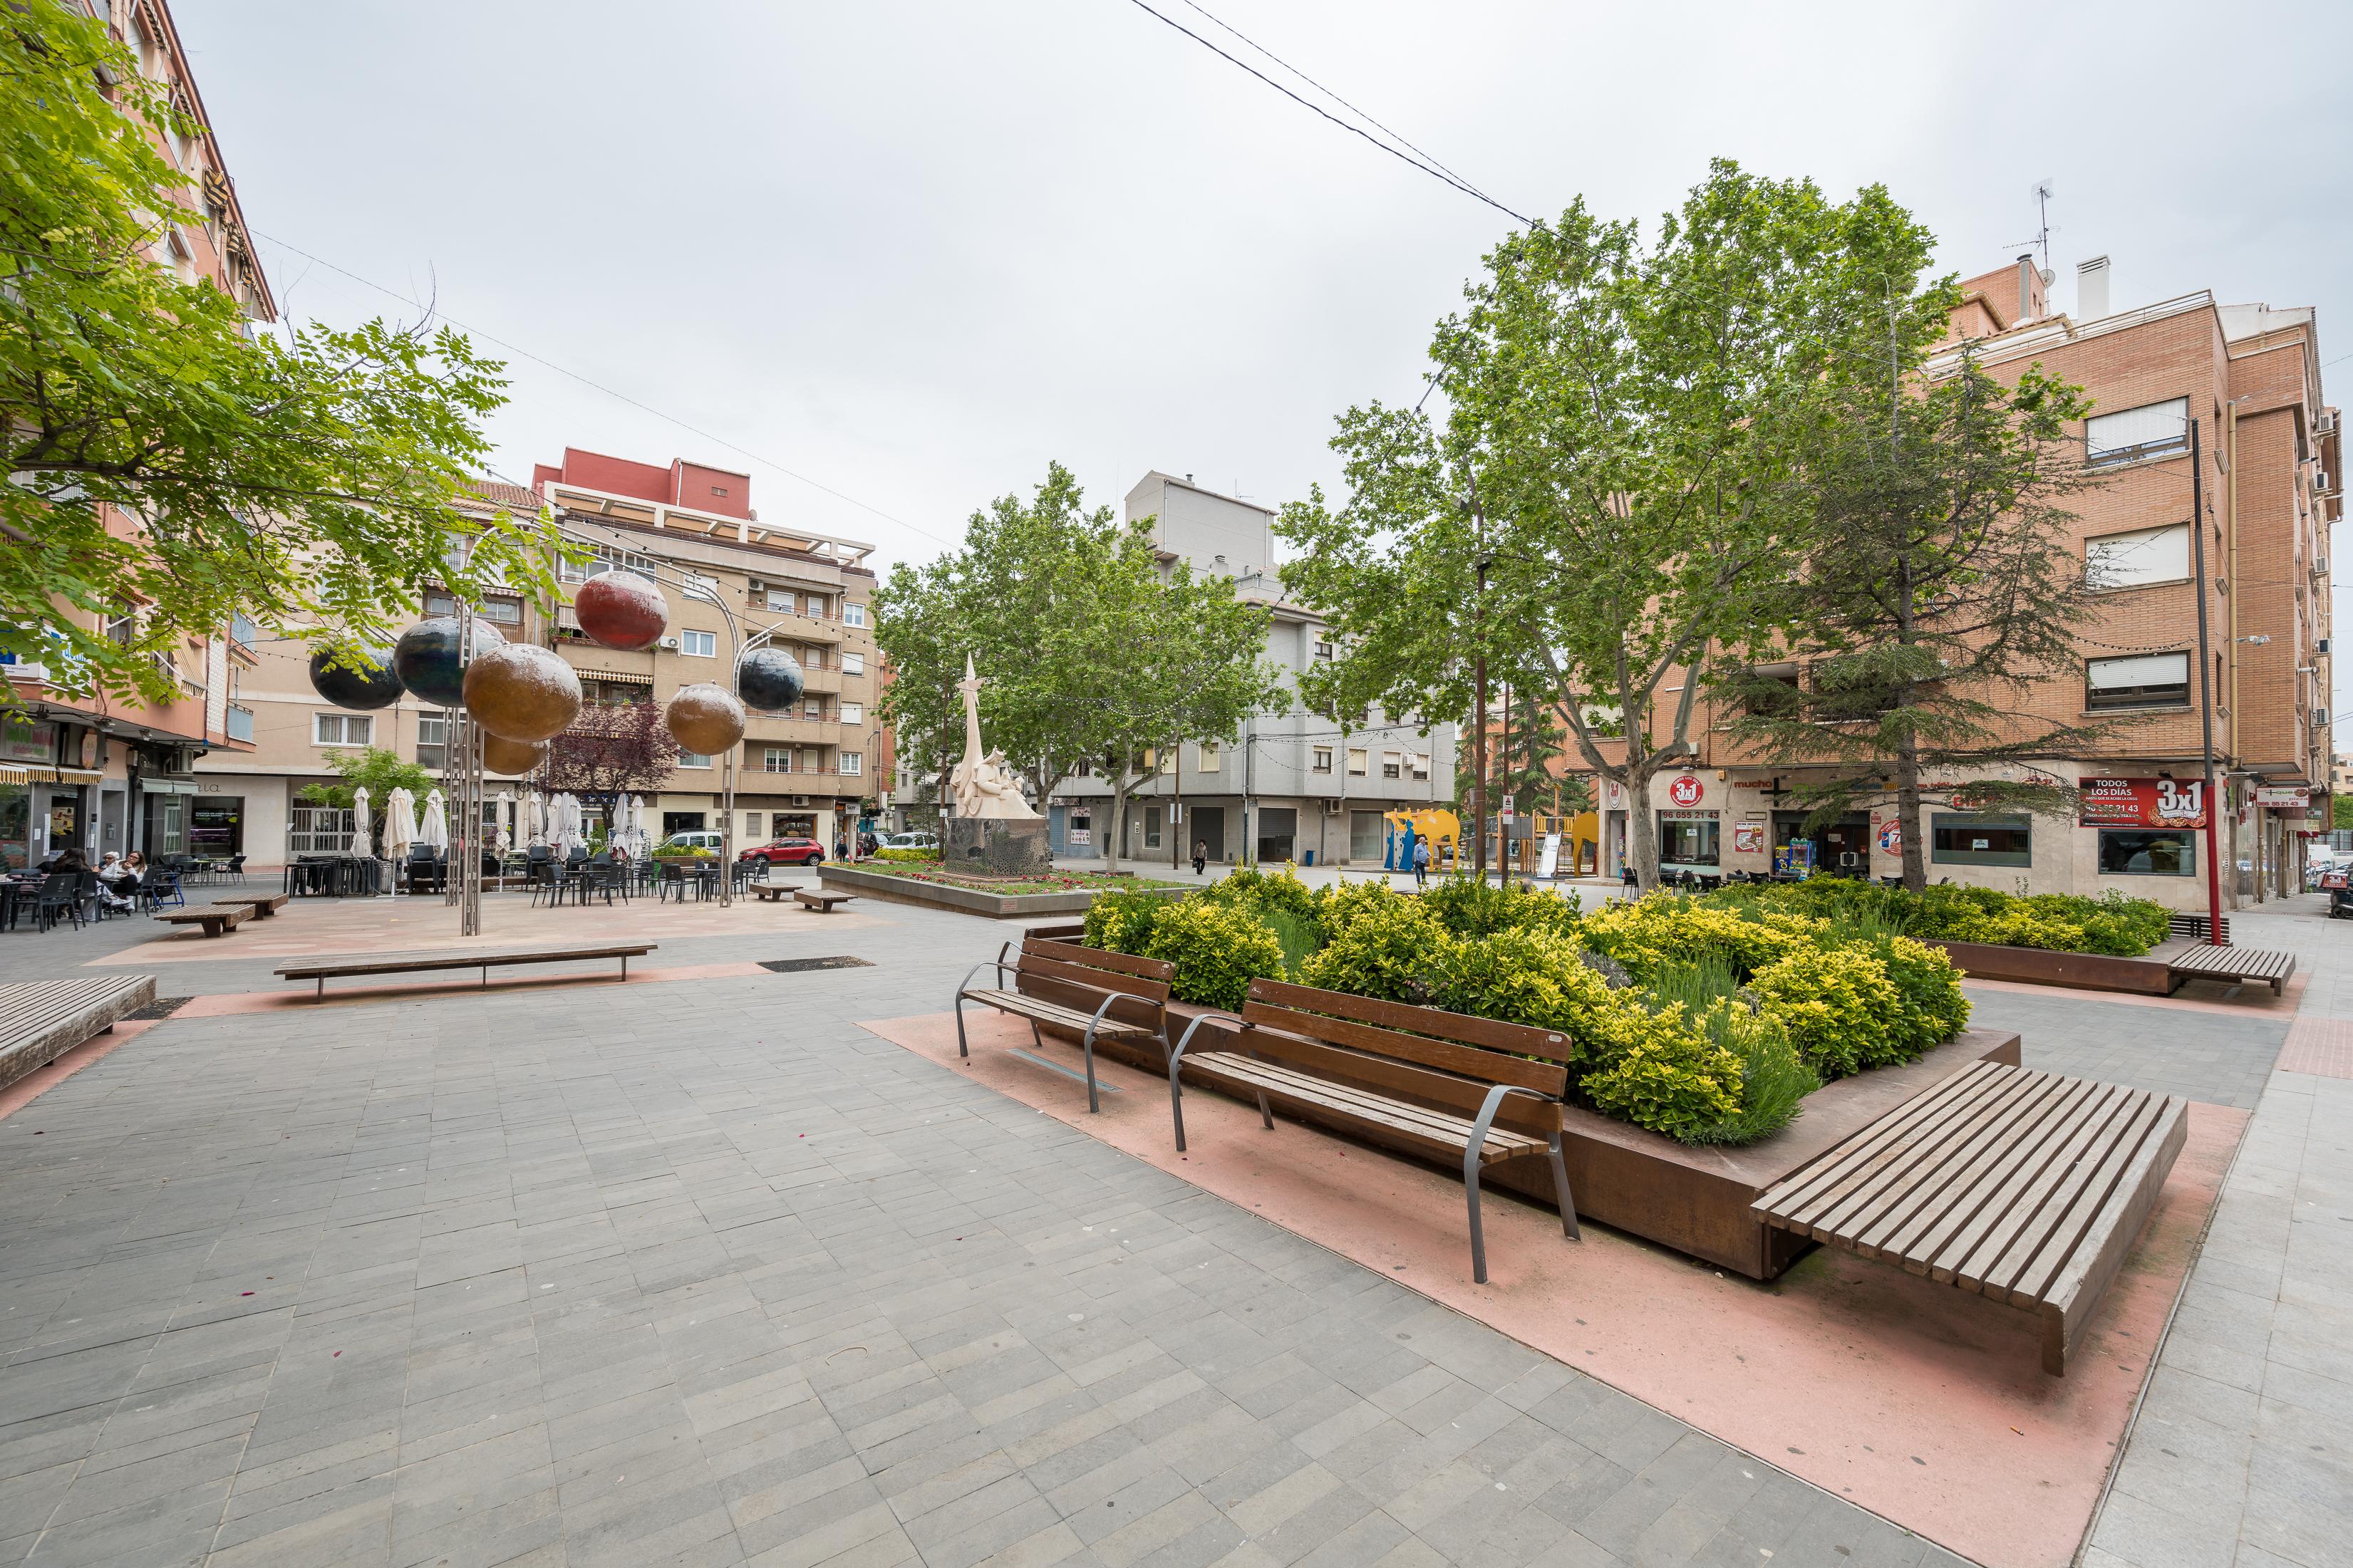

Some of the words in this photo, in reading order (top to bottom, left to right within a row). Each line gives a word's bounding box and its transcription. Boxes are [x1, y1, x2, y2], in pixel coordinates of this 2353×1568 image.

[1673, 777, 1684, 786] TODOS
[1734, 779, 1772, 788] mucho
[1676, 783, 1696, 799] 3x1
[2110, 786, 2132, 796] DÍAS
[2157, 780, 2202, 810] 3x1
